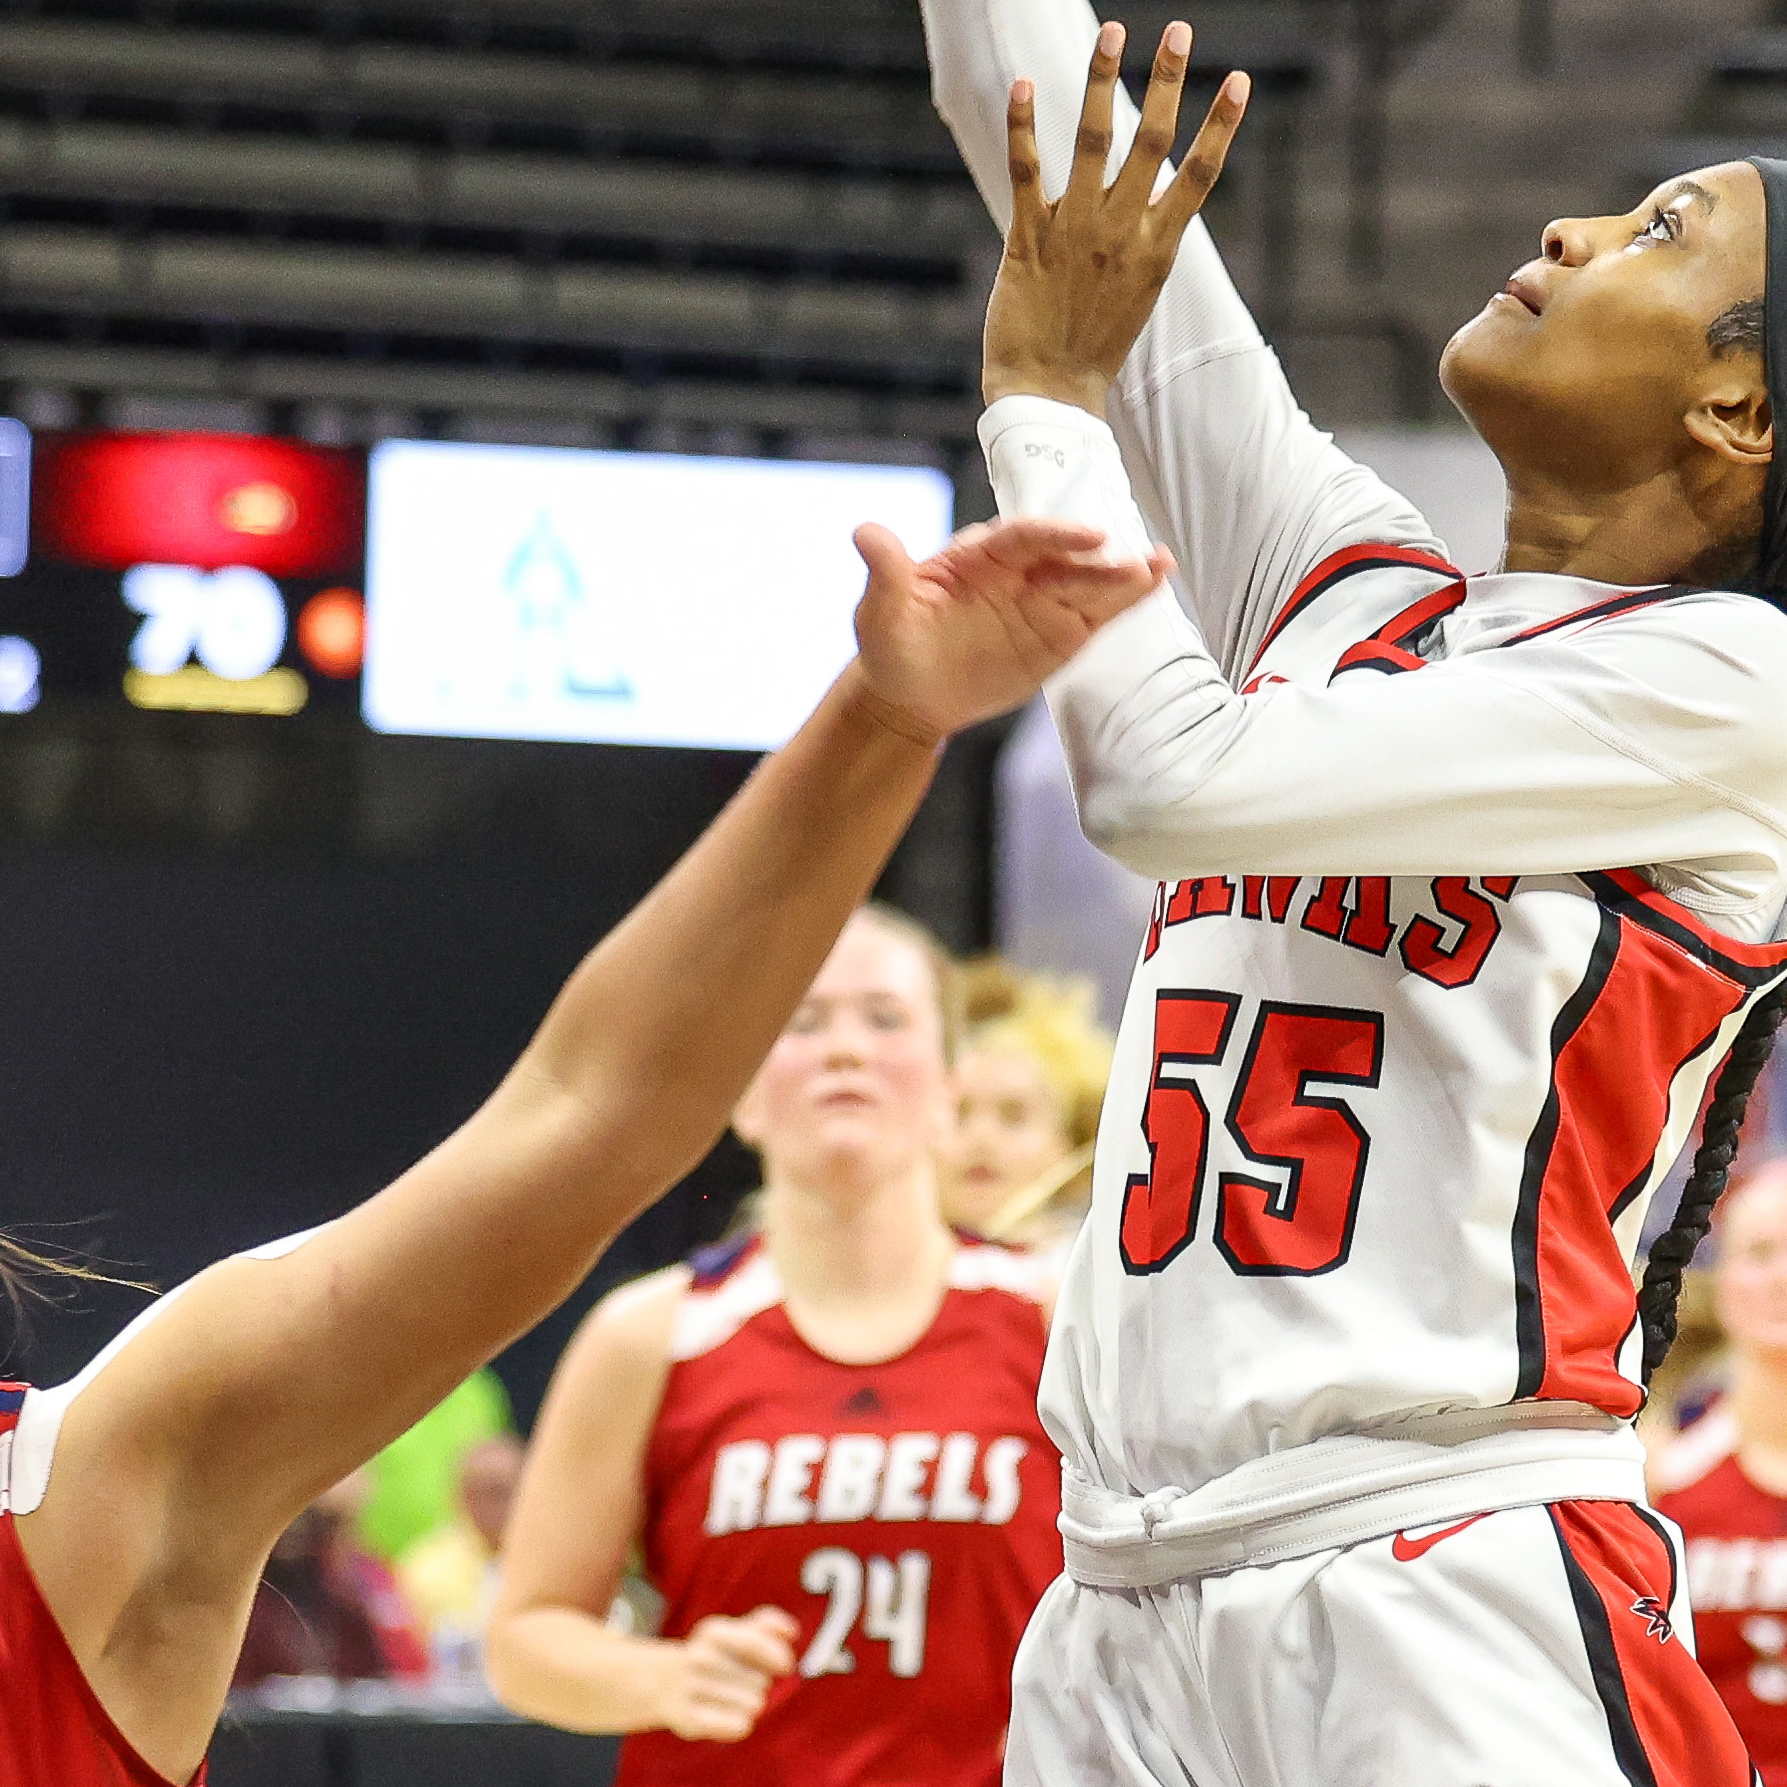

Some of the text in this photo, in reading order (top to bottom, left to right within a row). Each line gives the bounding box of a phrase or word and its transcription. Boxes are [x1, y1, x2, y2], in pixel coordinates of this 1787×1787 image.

[122, 562, 287, 680] 70
[1118, 987, 1385, 1275] 55
[704, 1430, 1030, 1538] REBELS
[798, 1545, 932, 1679] 24
